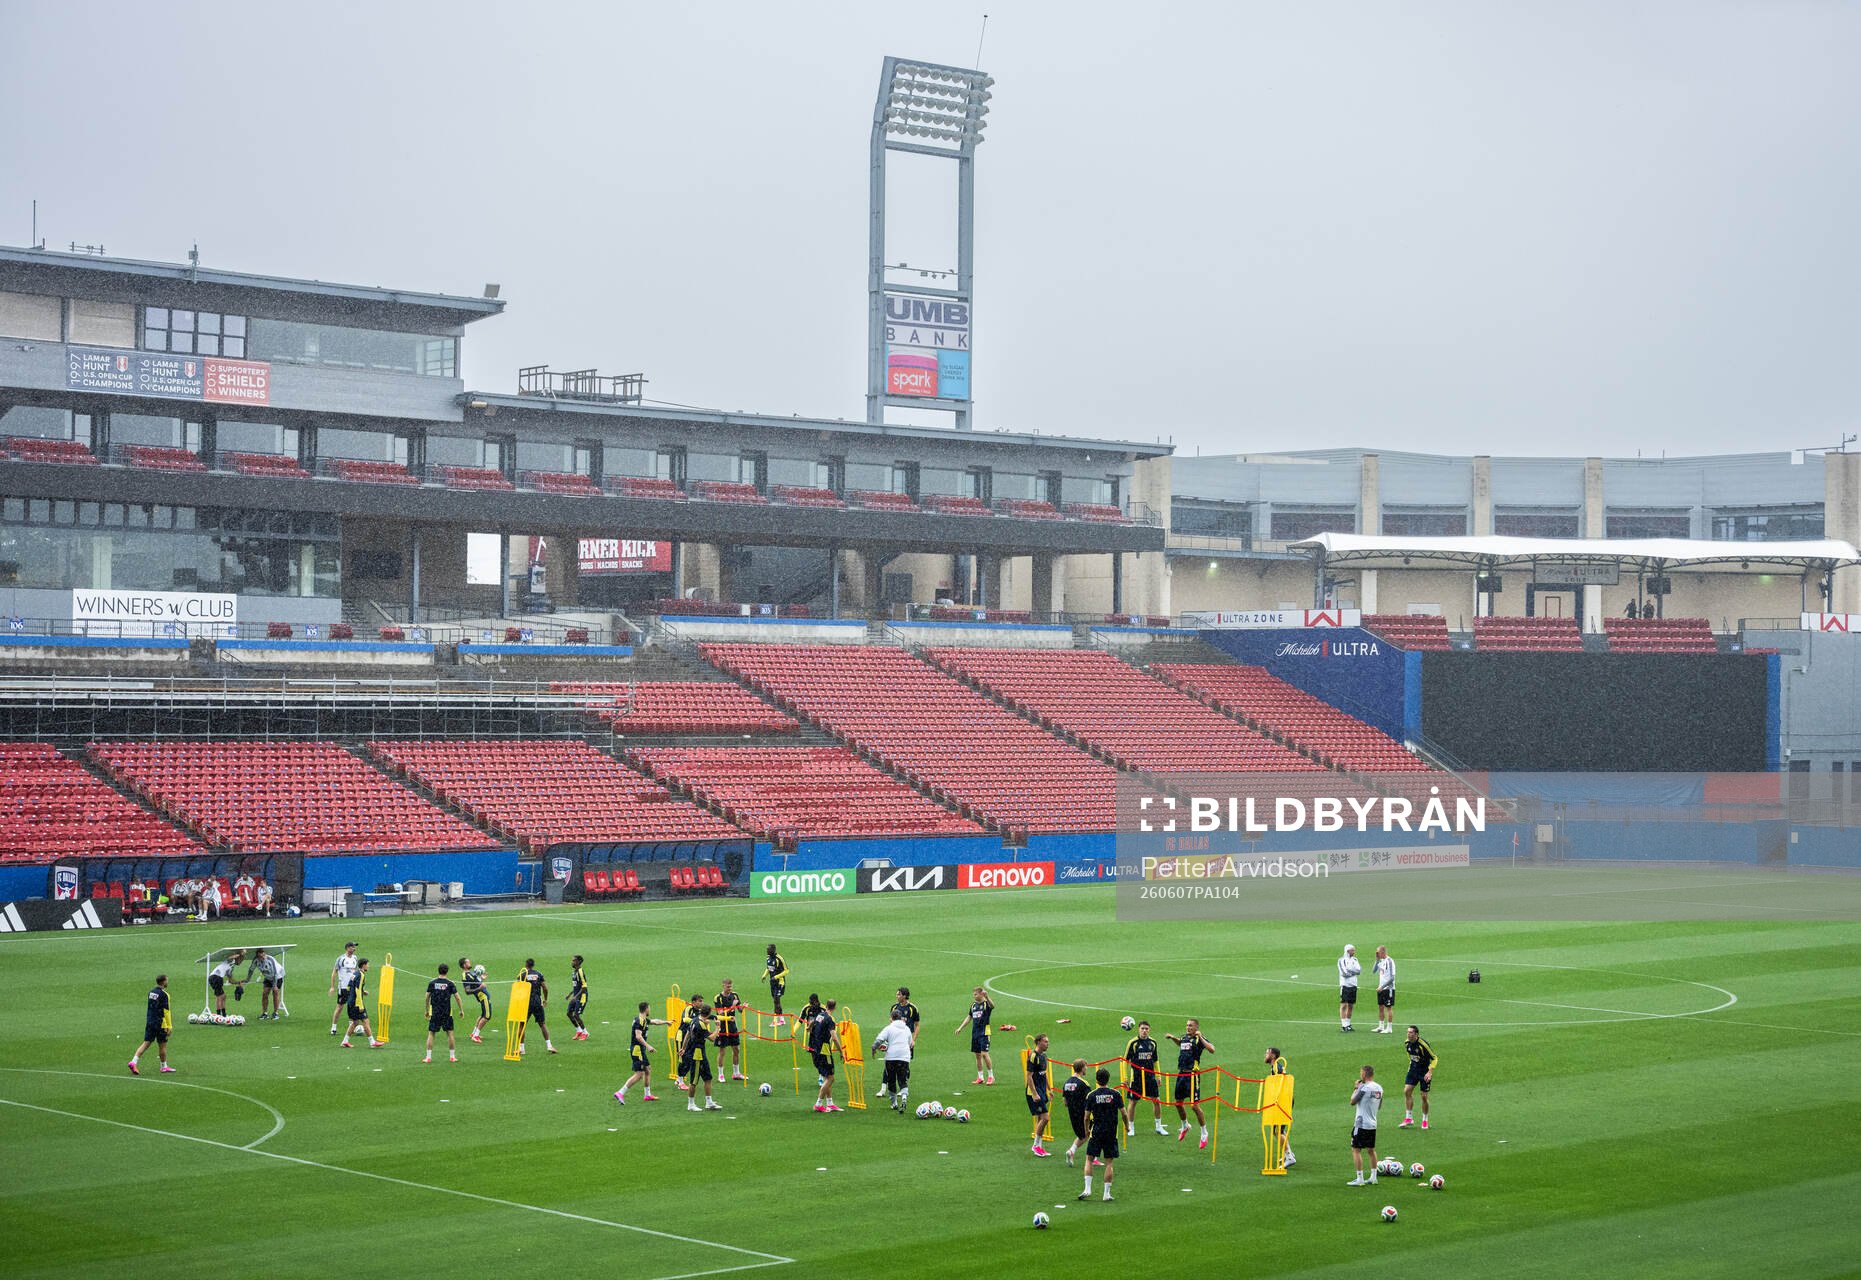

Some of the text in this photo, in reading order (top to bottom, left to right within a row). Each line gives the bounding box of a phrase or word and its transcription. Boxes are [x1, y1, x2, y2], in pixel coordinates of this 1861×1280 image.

[886, 298, 968, 325] UMB
[886, 327, 967, 348] BANK
[83, 354, 111, 362] LAMAR
[70, 353, 81, 385] 1997
[83, 362, 110, 371] HUNT
[152, 368, 179, 377] HUNT
[140, 360, 150, 390] 2016
[207, 364, 217, 394] 2016
[218, 374, 265, 388] SHIELD
[894, 370, 931, 389] spark
[83, 379, 133, 389] CHAMPIONS
[152, 385, 201, 395] CHAMPIONS
[218, 386, 266, 399] WINNERS
[578, 539, 657, 559] RNER KICK
[77, 597, 163, 616] WINNERS
[186, 599, 234, 618] CLUB
[10, 621, 24, 630] 106
[1223, 614, 1250, 623] ULTRA
[1254, 614, 1283, 623] ZONE
[1276, 640, 1379, 657] Michelob ULTRA
[1396, 851, 1468, 864] verizon business
[968, 865, 1045, 887] Lenovo
[1060, 865, 1140, 879] Michelob ULTRA
[762, 873, 845, 893] aramco
